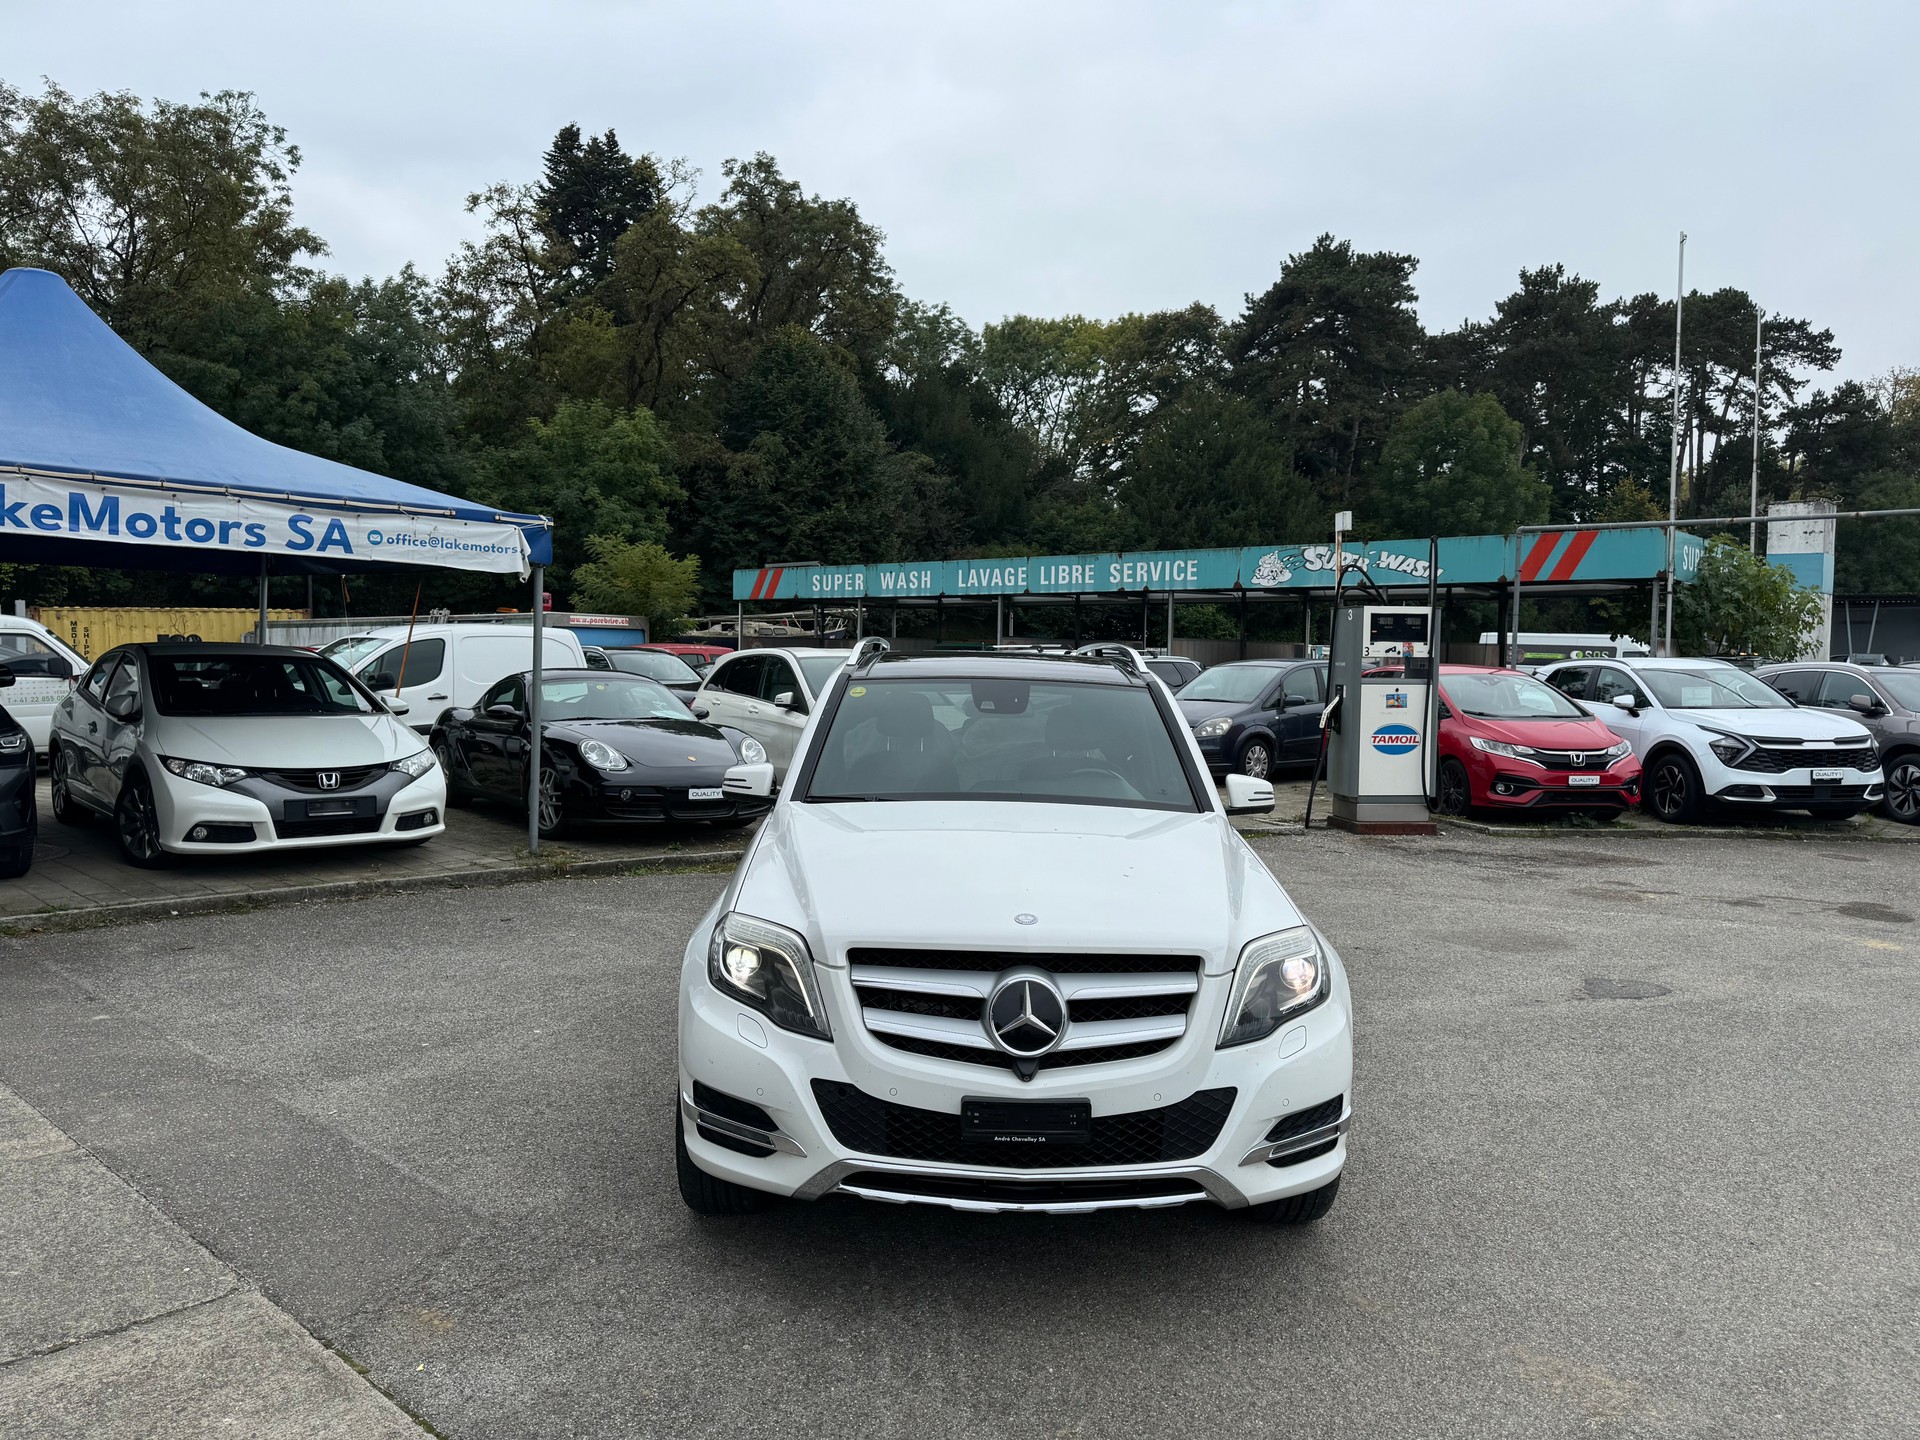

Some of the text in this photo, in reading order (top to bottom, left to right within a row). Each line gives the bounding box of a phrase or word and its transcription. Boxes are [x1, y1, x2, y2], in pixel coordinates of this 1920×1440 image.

[285, 514, 354, 554] SA
[1303, 546, 1369, 572] SUPER
[812, 560, 1198, 592] SUPER WASH LAVAGE LIBRE SERVICE
[1347, 609, 1353, 621] 3
[1364, 646, 1370, 657] 3
[1371, 735, 1420, 744] TAMOIL
